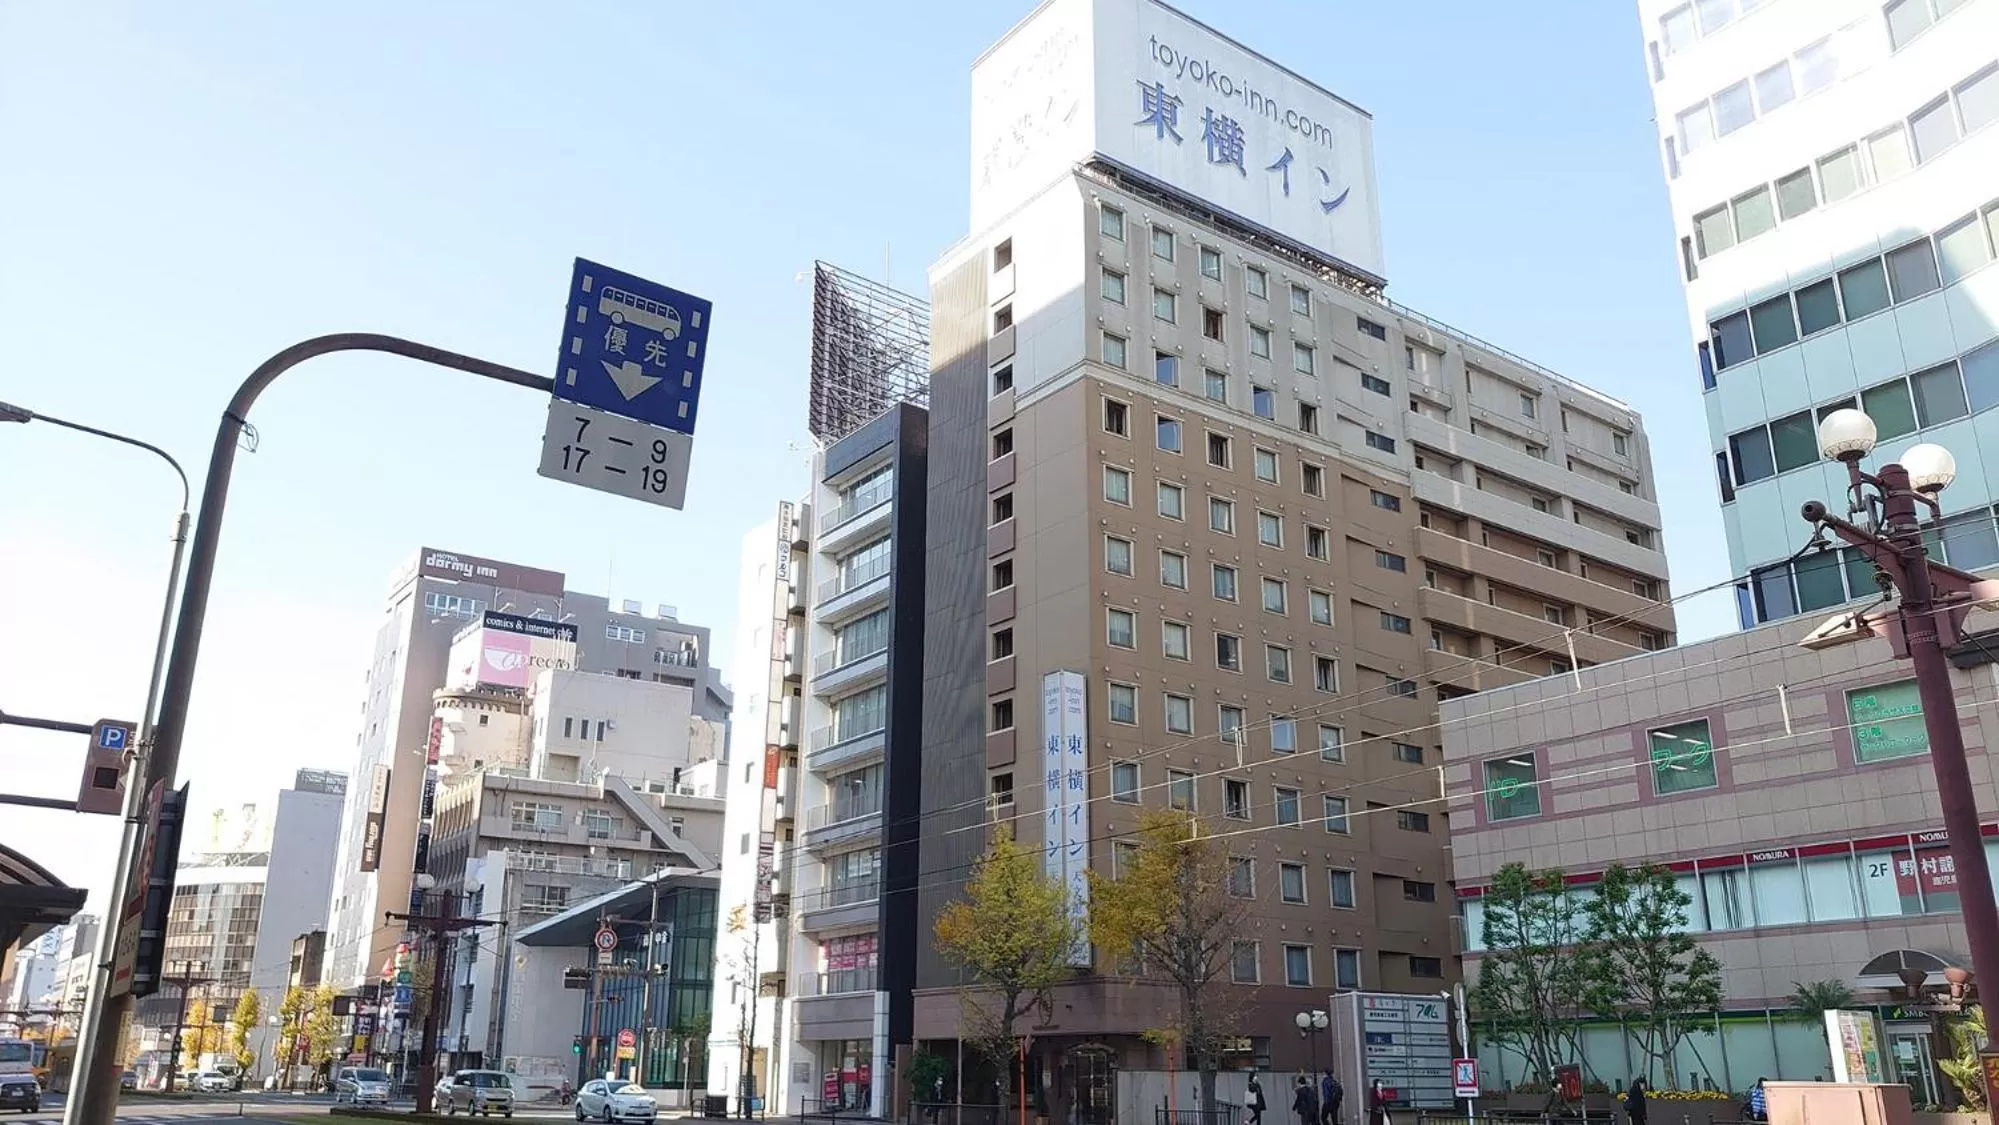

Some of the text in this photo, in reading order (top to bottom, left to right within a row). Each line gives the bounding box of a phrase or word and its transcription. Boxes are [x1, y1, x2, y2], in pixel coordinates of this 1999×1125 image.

[1150, 34, 1333, 149] toyoko-inn.com
[1134, 79, 1351, 215] 東横イン
[604, 325, 668, 368] 優先
[576, 416, 591, 443] 7
[651, 439, 667, 464] 9
[562, 445, 590, 473] 17
[642, 465, 668, 493] 19
[426, 553, 497, 578] dormy inn
[486, 618, 514, 629] comics
[525, 622, 556, 636] internet
[106, 729, 121, 745] P
[1047, 735, 1061, 858] 東横イン
[1066, 735, 1084, 856] 東横イン
[1753, 851, 1789, 861] NOMURA
[1868, 863, 1888, 878] 2F
